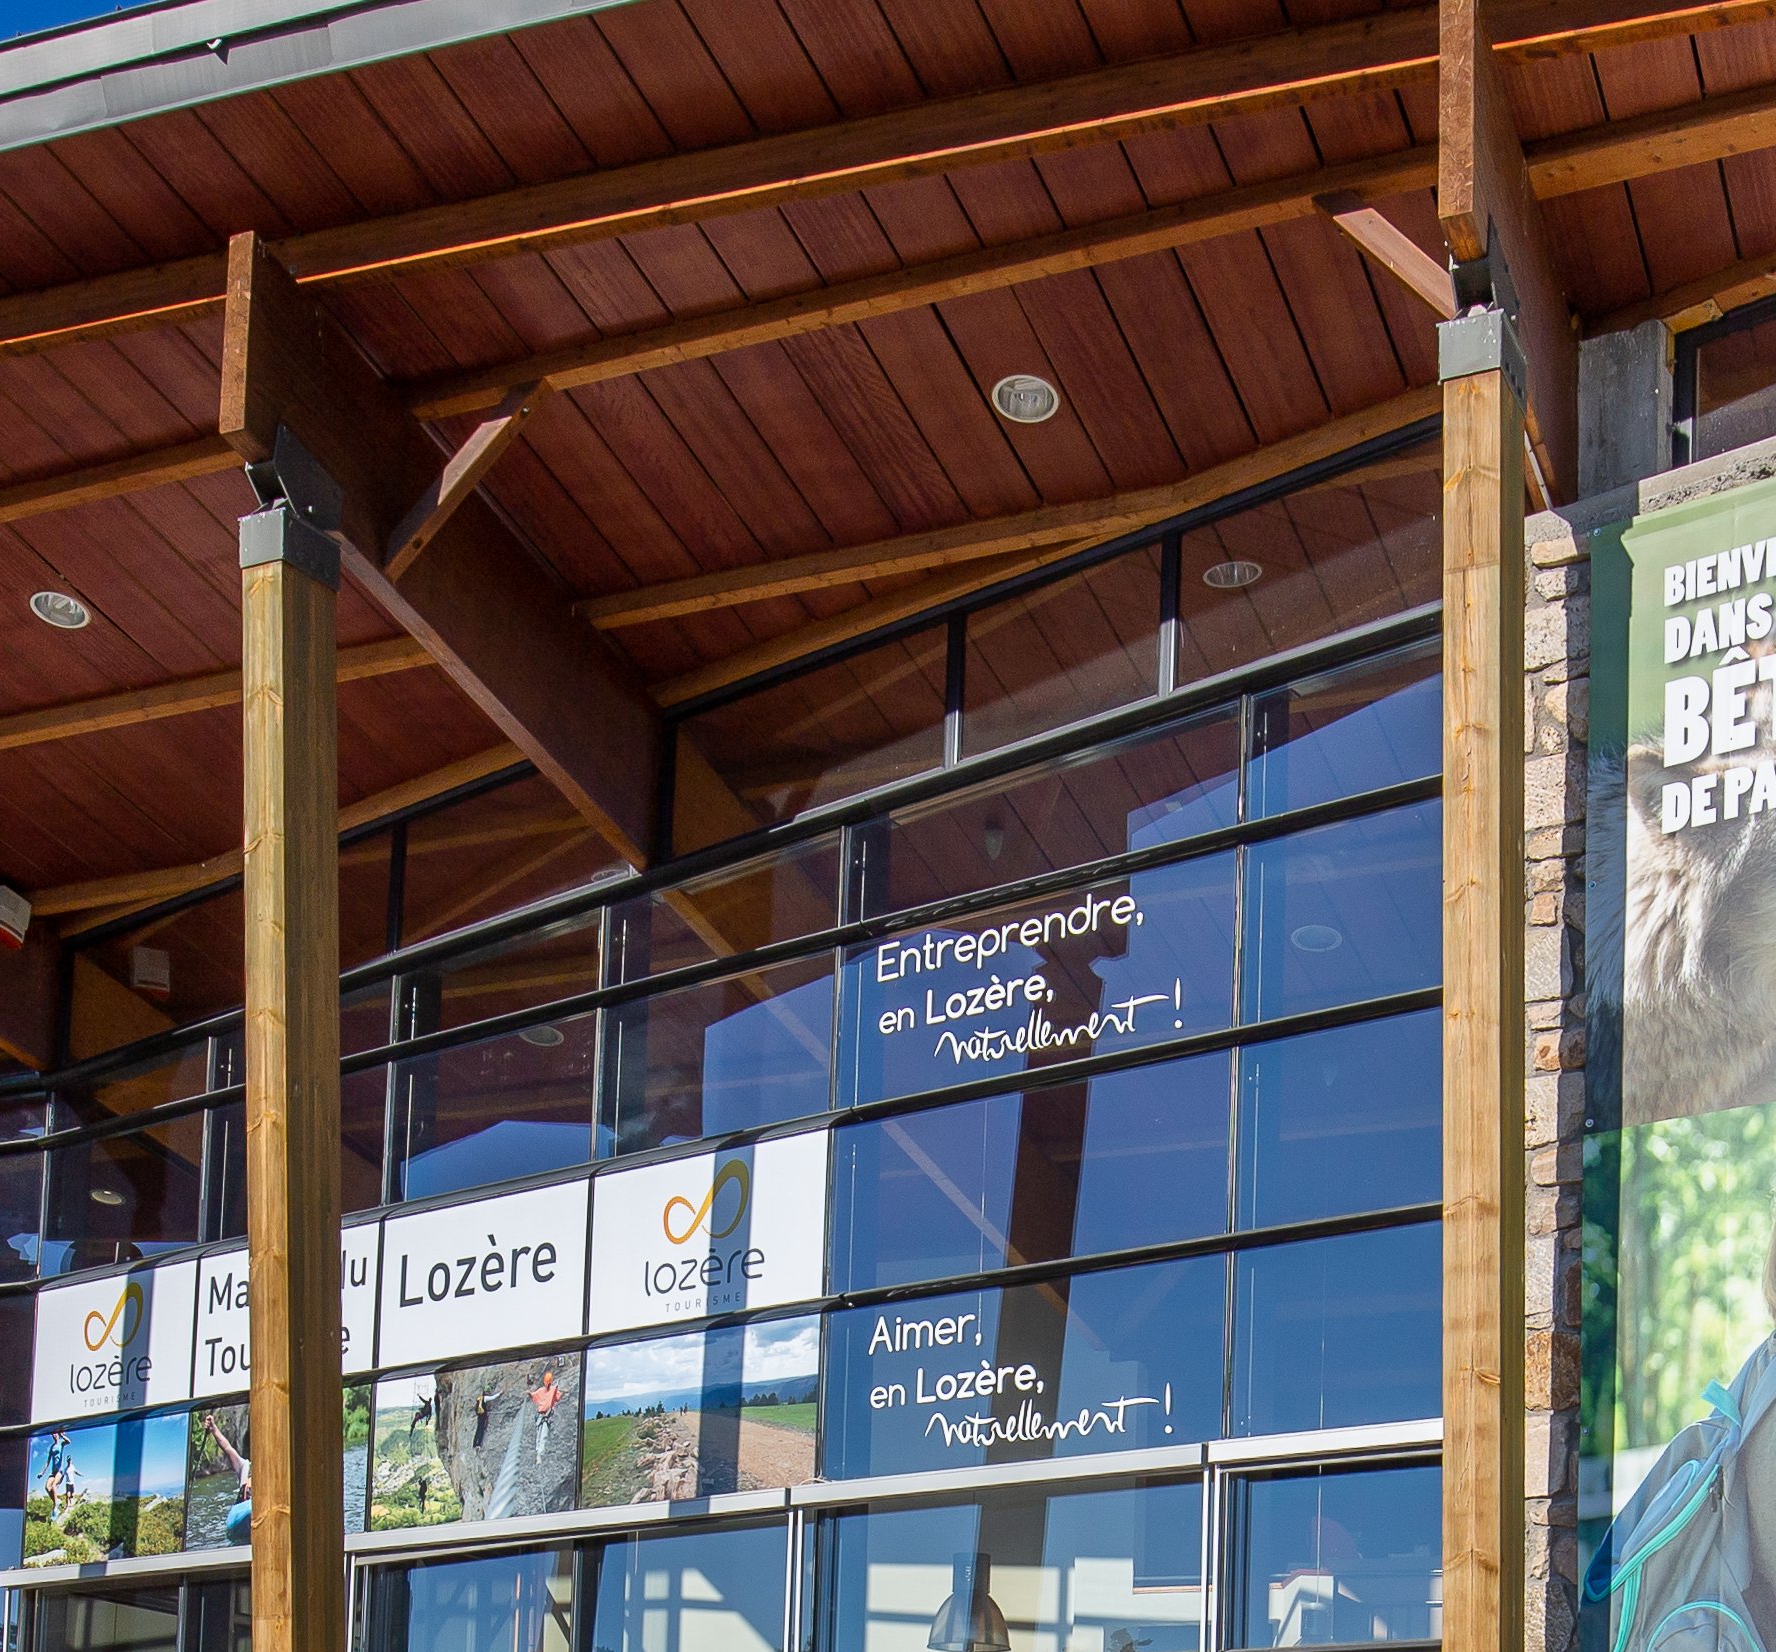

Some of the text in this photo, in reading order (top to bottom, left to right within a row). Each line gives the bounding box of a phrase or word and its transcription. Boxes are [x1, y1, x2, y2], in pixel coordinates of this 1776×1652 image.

[1663, 591, 1773, 665] DANS
[1661, 774, 1717, 835] DE
[876, 892, 1146, 983] Entreprendre,
[878, 973, 1055, 1035] en Lozère,
[399, 1233, 558, 1308] Lozère
[645, 1247, 765, 1297] lozère
[665, 1291, 741, 1313] TOURISME
[867, 1311, 983, 1356] Aimer,
[69, 1355, 152, 1394] lozère
[84, 1391, 136, 1408] TOURISME
[870, 1360, 1045, 1410] en Lozère,
